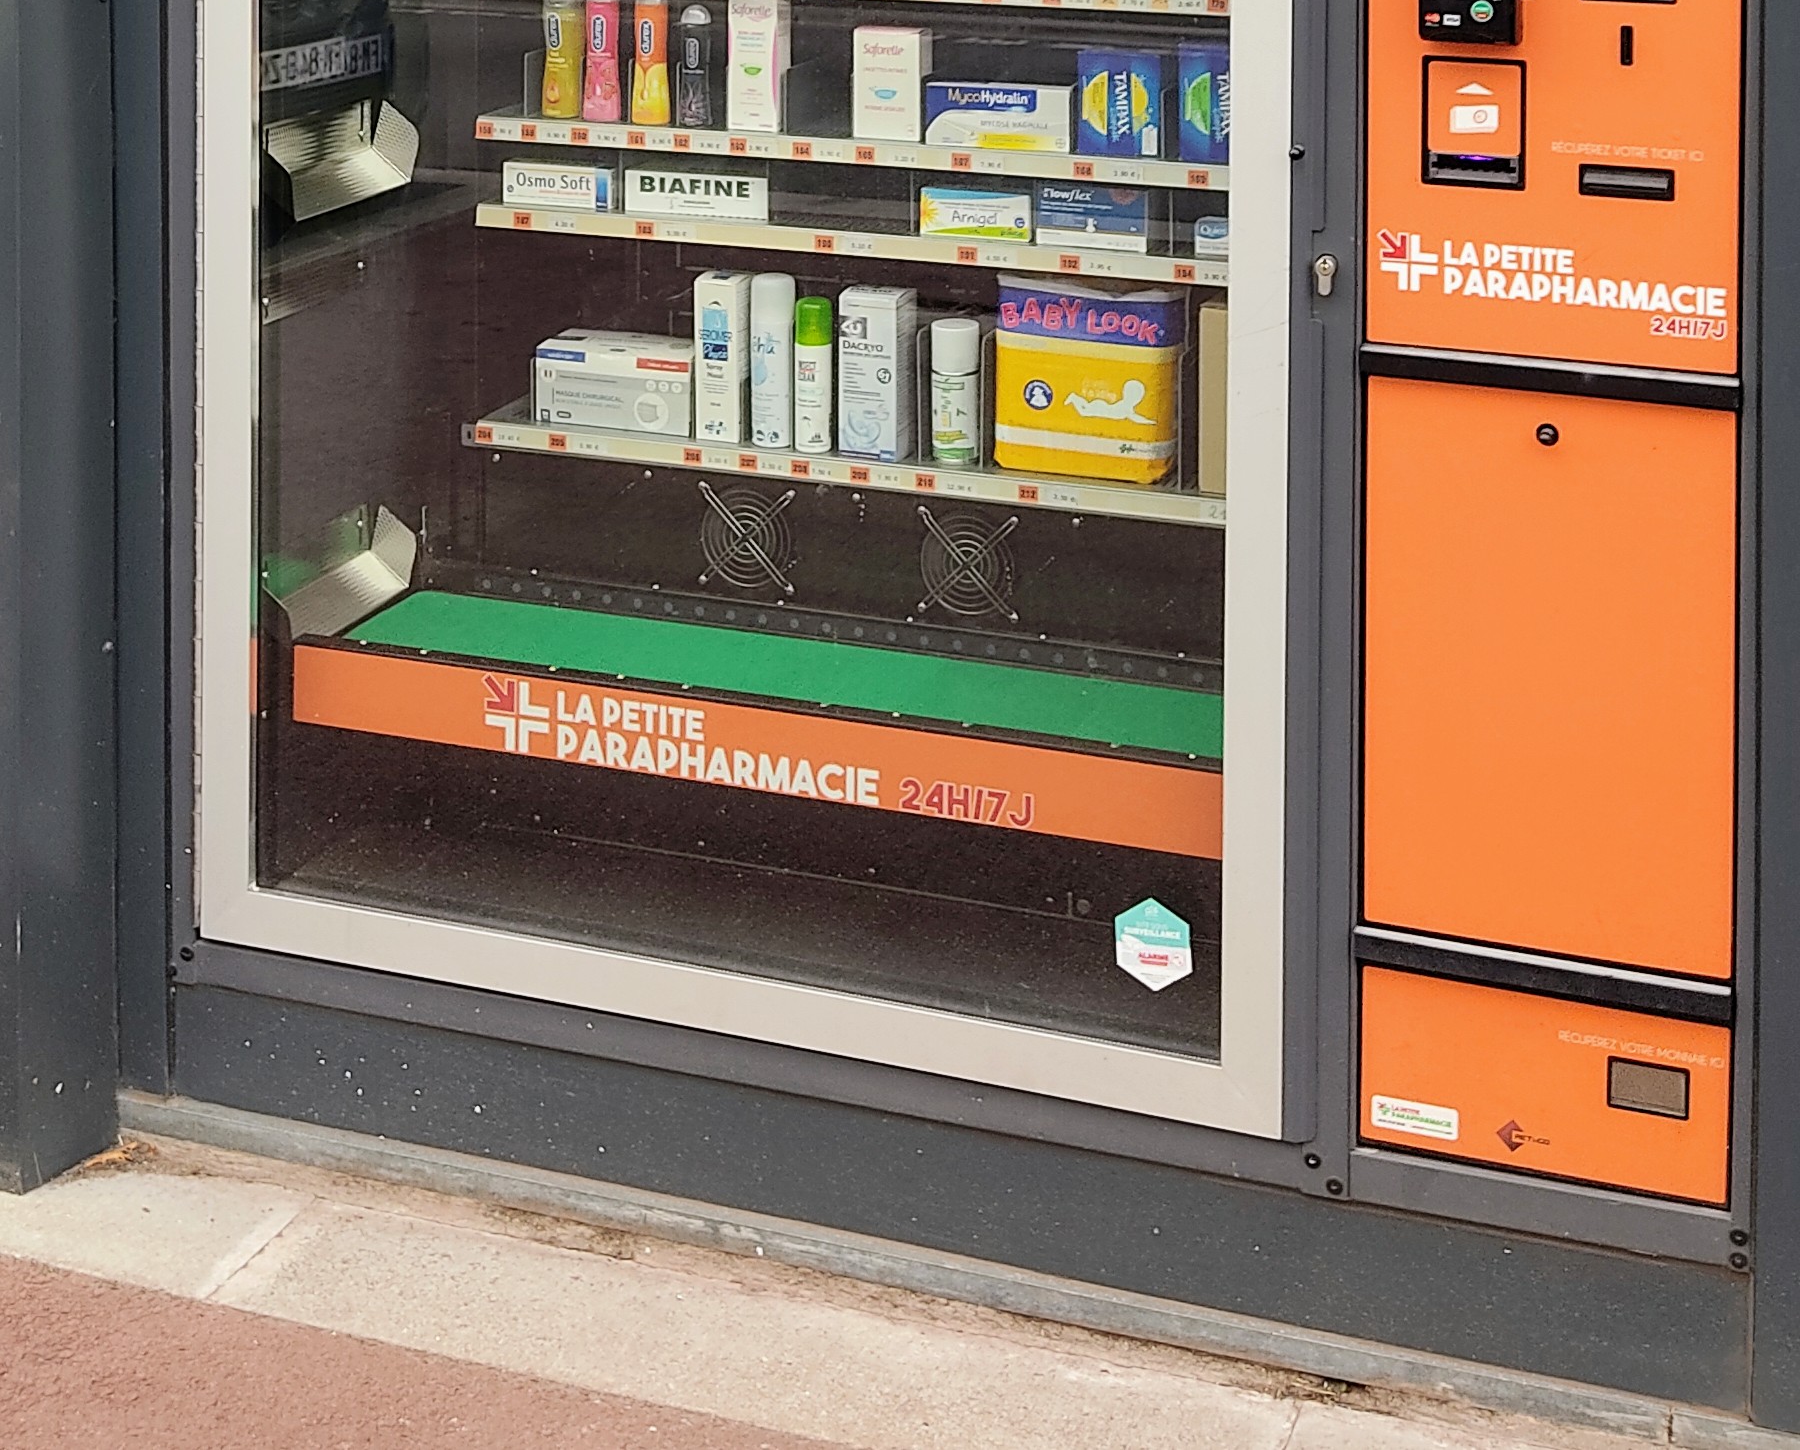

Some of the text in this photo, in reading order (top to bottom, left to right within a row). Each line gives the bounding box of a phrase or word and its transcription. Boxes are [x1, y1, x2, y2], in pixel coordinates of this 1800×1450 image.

[551, 15, 561, 48] durex
[594, 18, 604, 49] durex
[642, 22, 652, 53] durex
[688, 41, 698, 66] durex
[947, 87, 1029, 107] MycoHydralin
[1113, 70, 1130, 135] TAMPAX
[516, 171, 591, 191] Osmo Soft
[640, 175, 750, 198] BIAFINE
[1043, 186, 1092, 202] Flowflex
[951, 210, 998, 227] Arnigel
[1443, 240, 1575, 274] LA PETITE
[1443, 268, 1728, 318] PARAPHARMACIE
[1000, 297, 1160, 345] BABY LOOK
[842, 340, 884, 353] DACRYO
[557, 689, 705, 741] LA PETITE
[557, 724, 879, 806] PARAPHARMACIE
